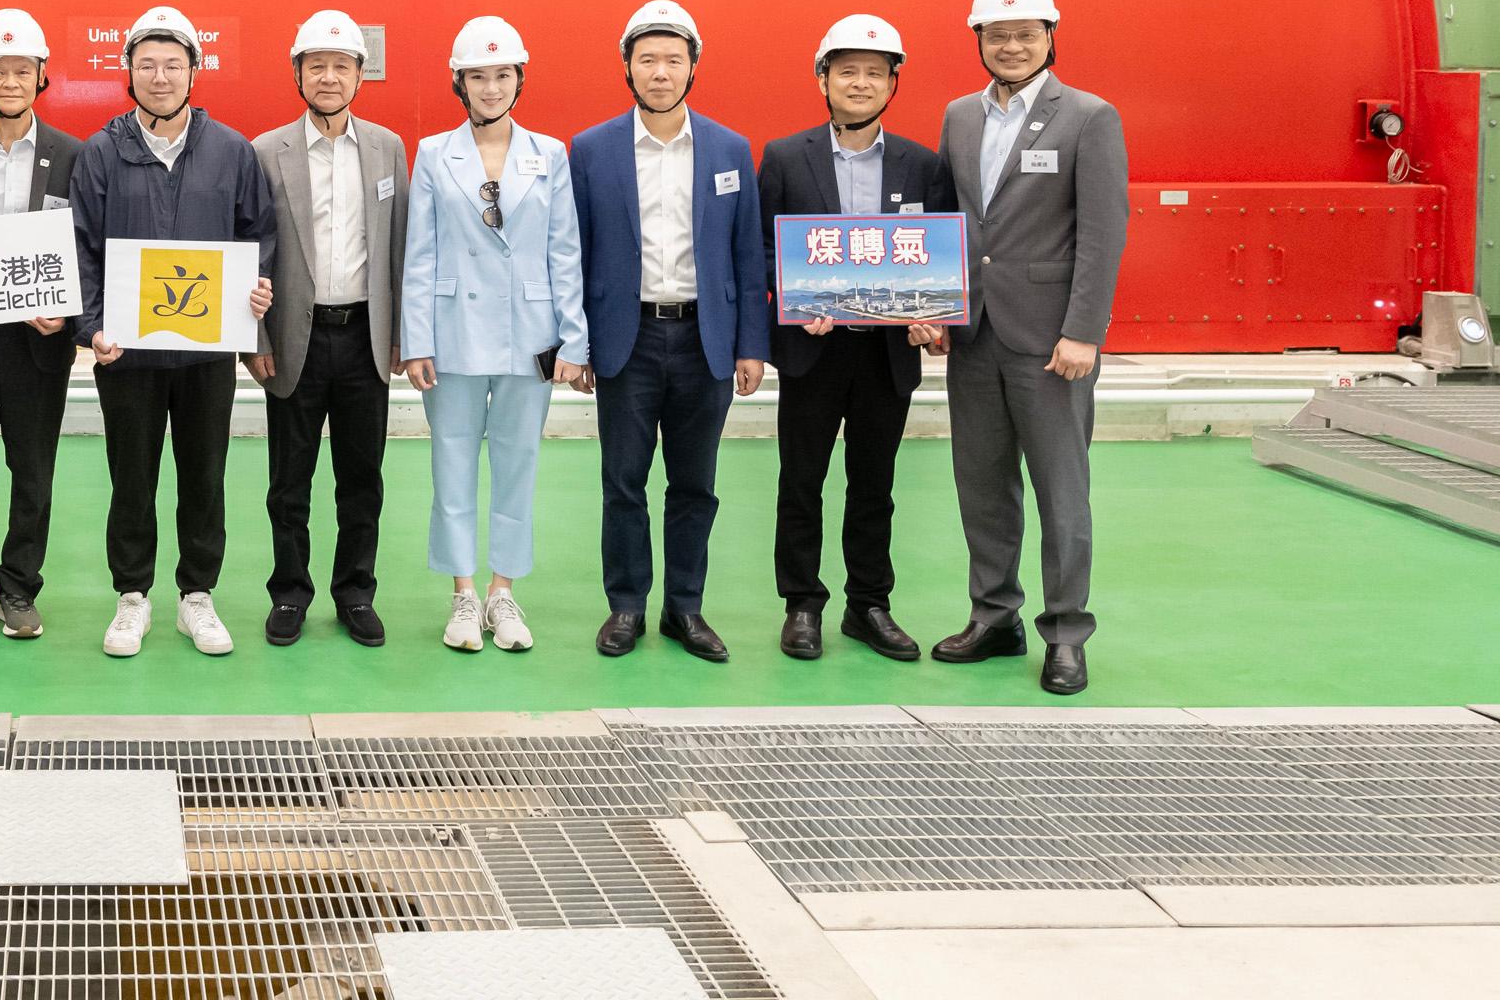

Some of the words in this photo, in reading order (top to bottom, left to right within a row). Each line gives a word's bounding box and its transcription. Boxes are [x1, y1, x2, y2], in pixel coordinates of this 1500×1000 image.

[88, 28, 120, 43] Unit
[806, 226, 930, 266] 煤轉氣
[1, 253, 65, 287] 港燈
